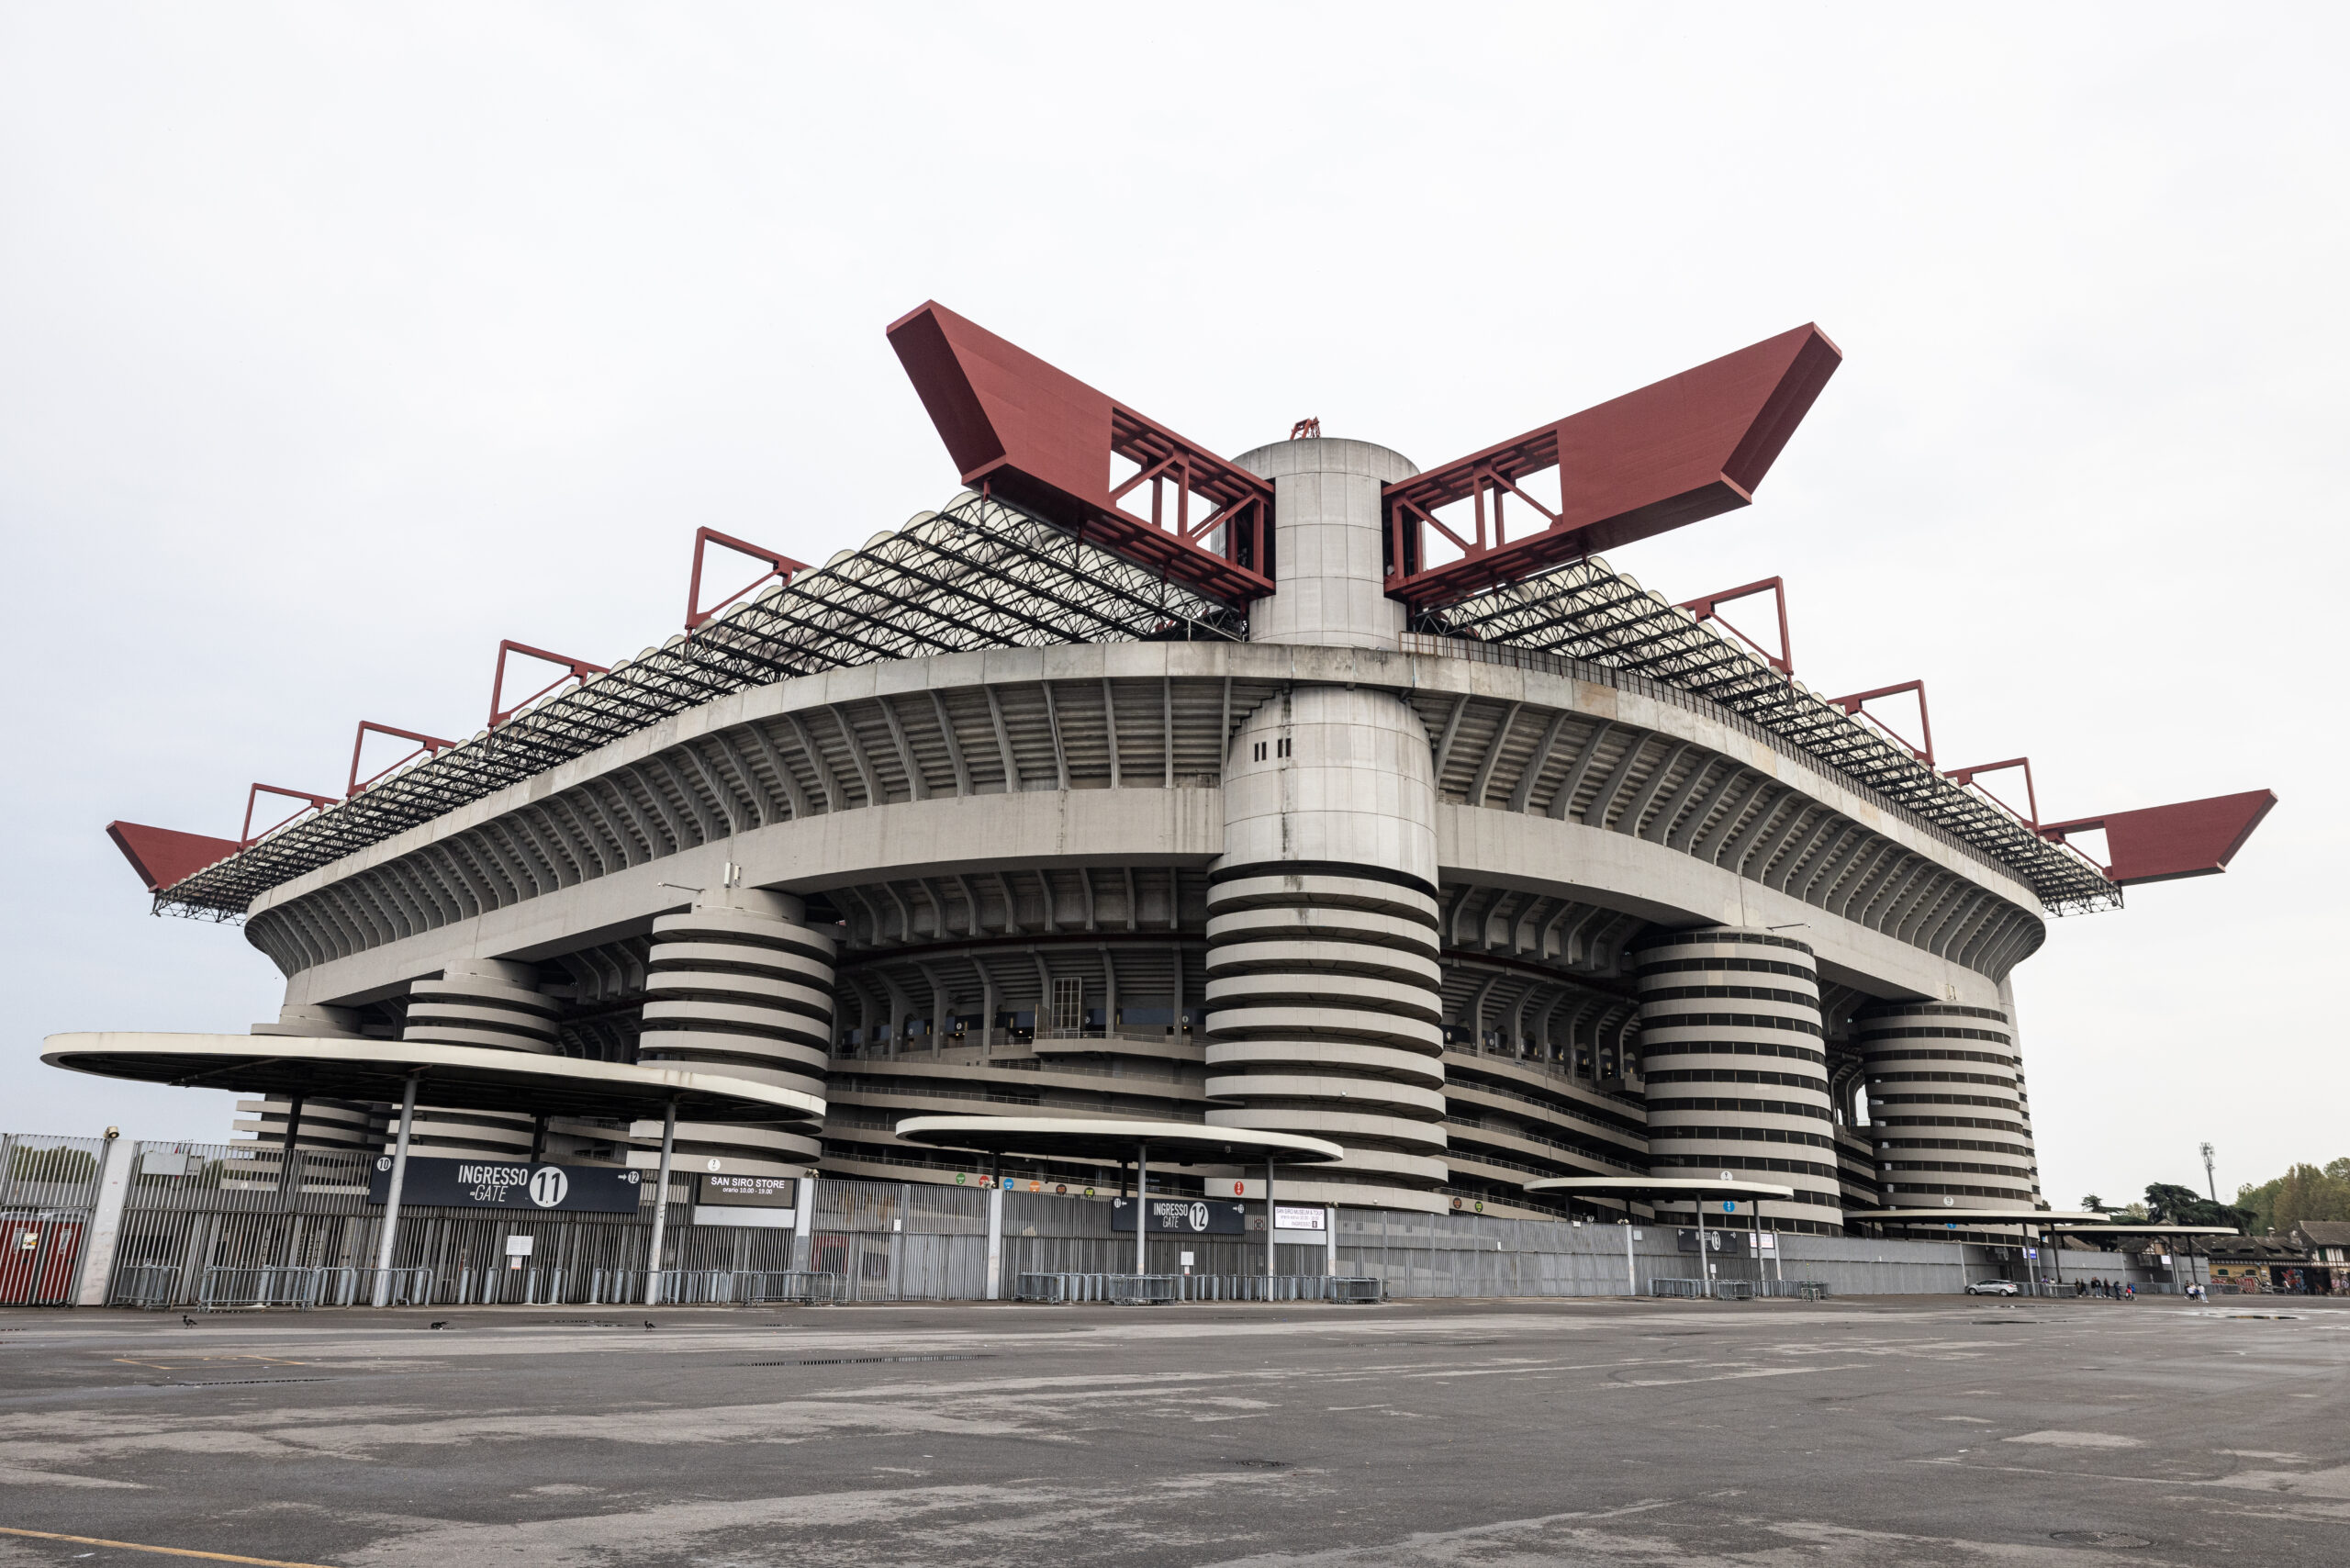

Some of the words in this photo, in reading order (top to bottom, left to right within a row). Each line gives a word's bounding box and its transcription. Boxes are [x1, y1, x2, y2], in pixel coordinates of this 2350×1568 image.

[379, 1159, 389, 1170] 10
[458, 1165, 529, 1186] INGRESSO
[630, 1172, 638, 1182] 12
[537, 1171, 561, 1203] 11
[711, 1177, 729, 1186] SAN
[732, 1178, 754, 1187] SIRO
[755, 1179, 785, 1189] STORE
[475, 1184, 509, 1202] GATE
[1153, 1203, 1189, 1216] INGRESSO
[1192, 1205, 1205, 1227] 12
[1162, 1215, 1180, 1228] GATE
[1712, 1232, 1720, 1248] 13
